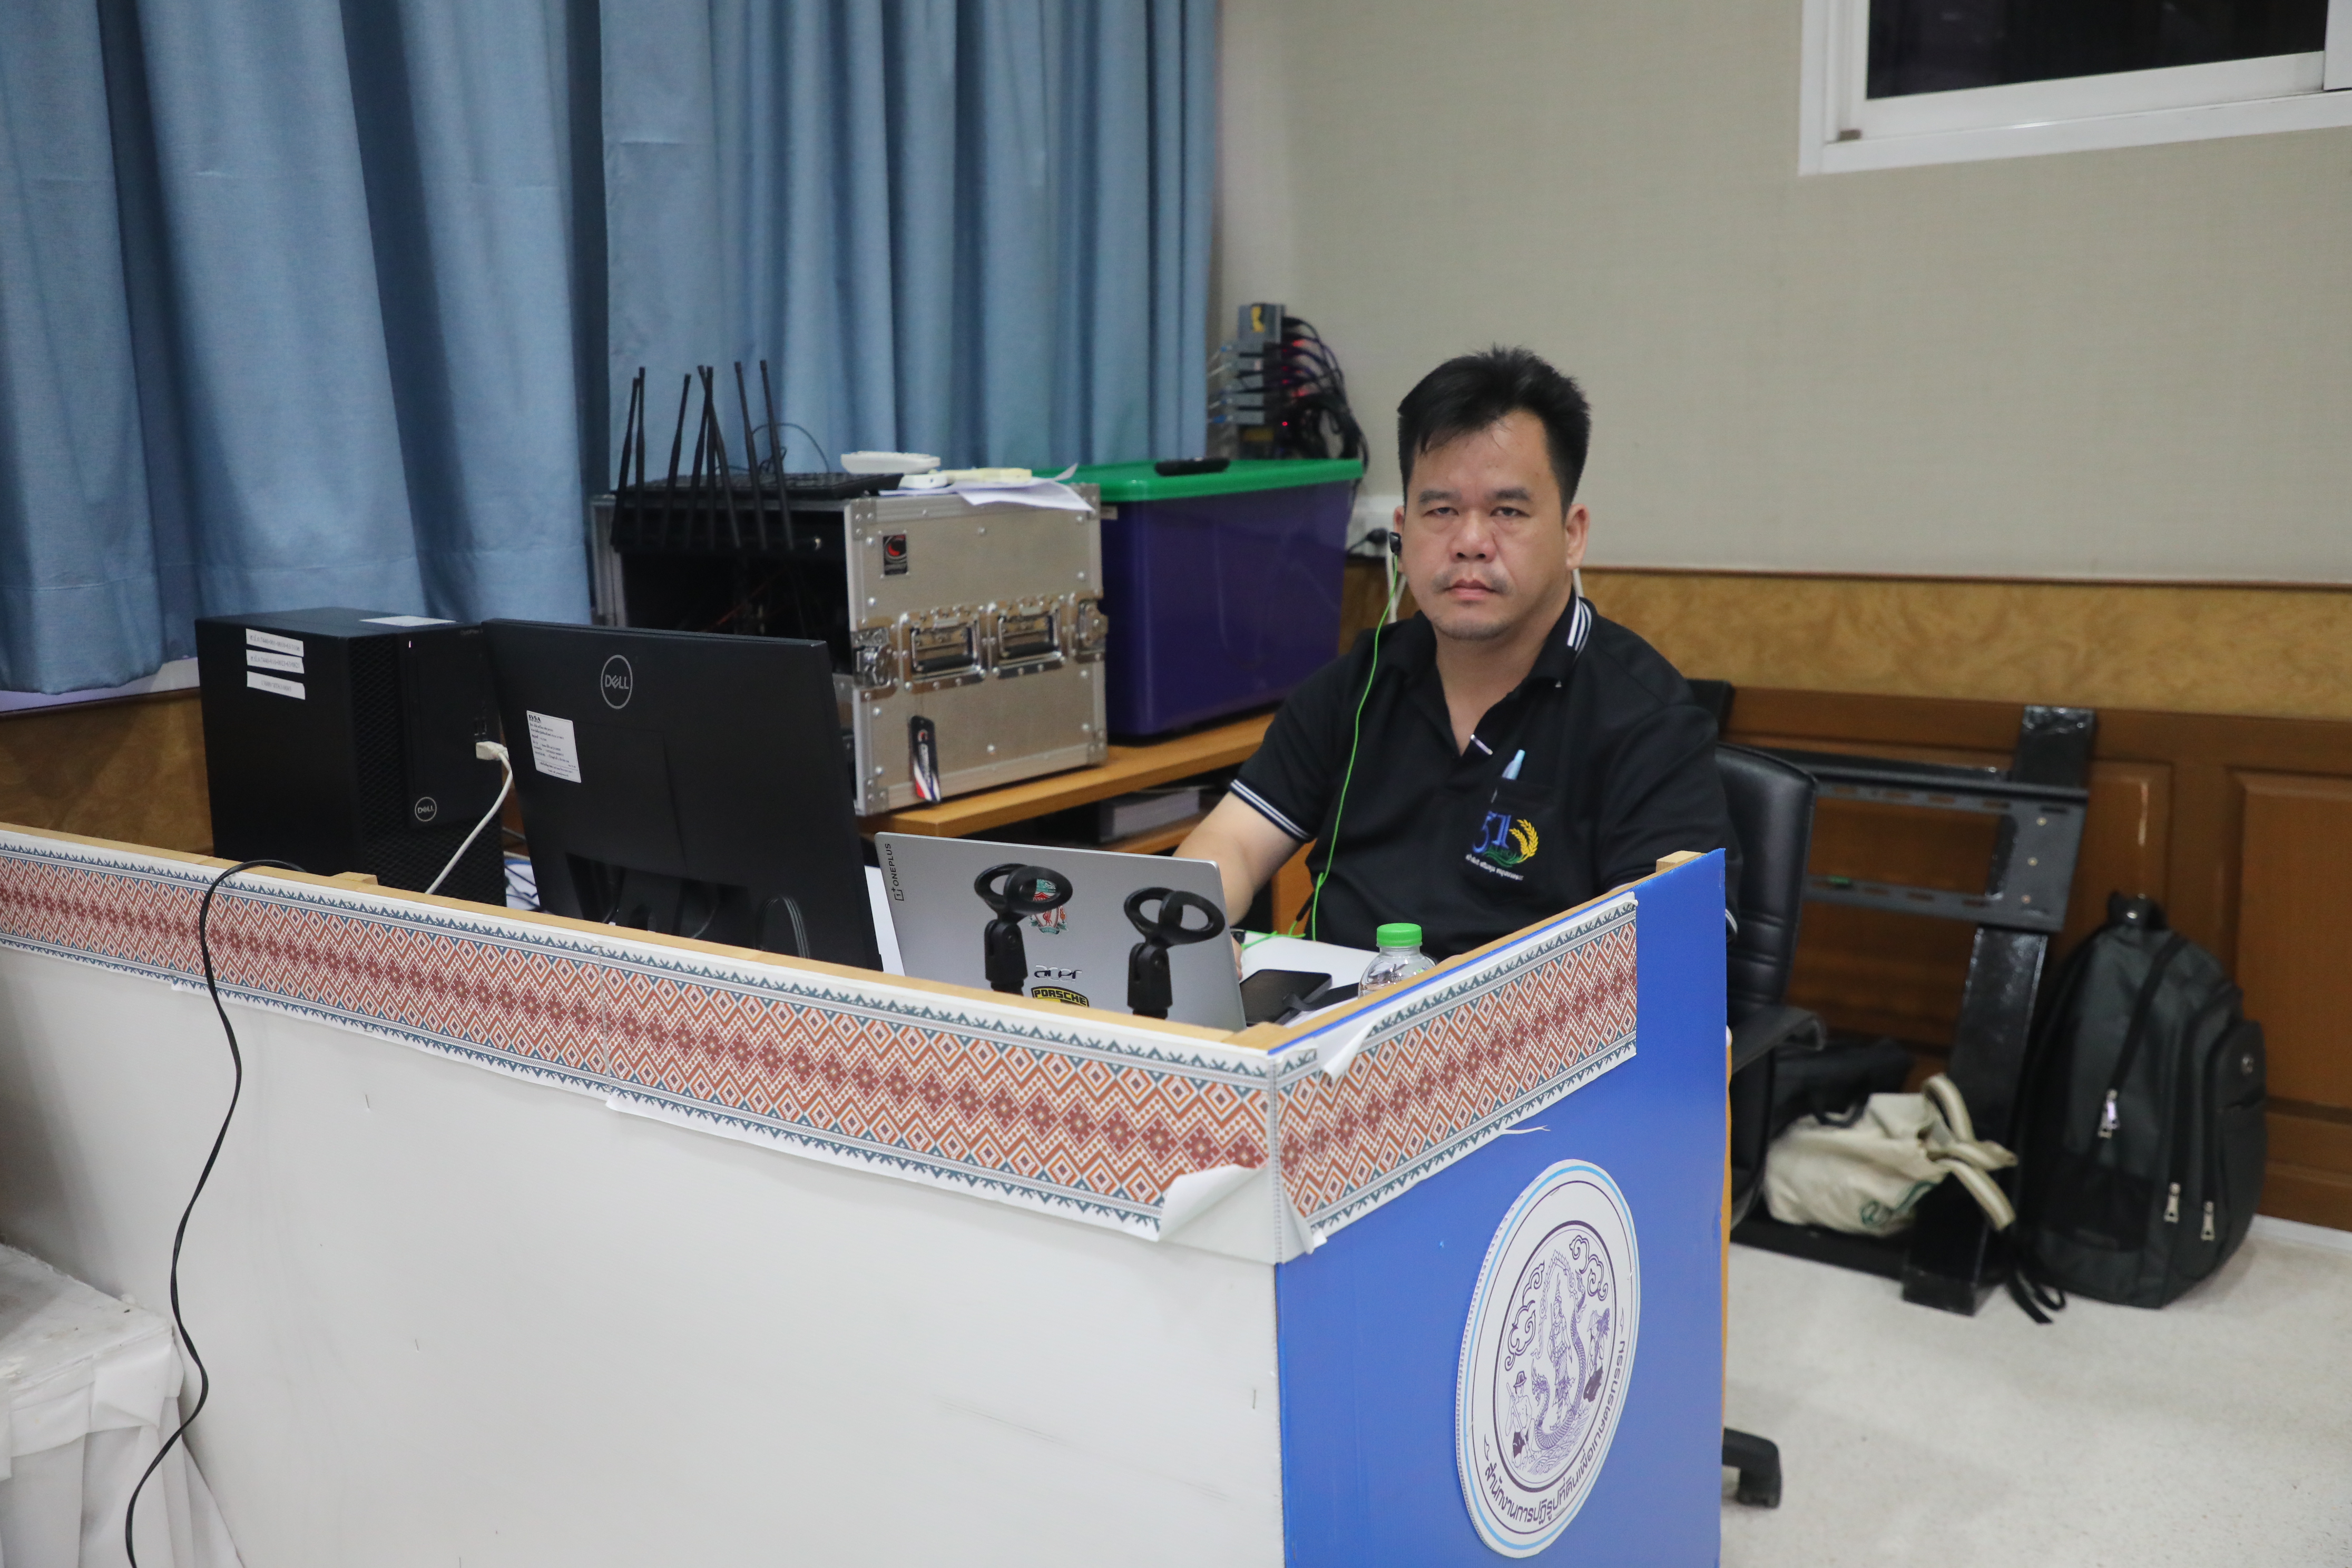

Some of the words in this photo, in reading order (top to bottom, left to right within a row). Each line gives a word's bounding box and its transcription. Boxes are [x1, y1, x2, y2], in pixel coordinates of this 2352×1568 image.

[604, 674, 629, 690] DELL
[417, 805, 435, 814] DELL
[885, 843, 899, 887] ONEPLUS
[1034, 965, 1083, 983] acer
[1034, 989, 1087, 1006] PORSCHE
